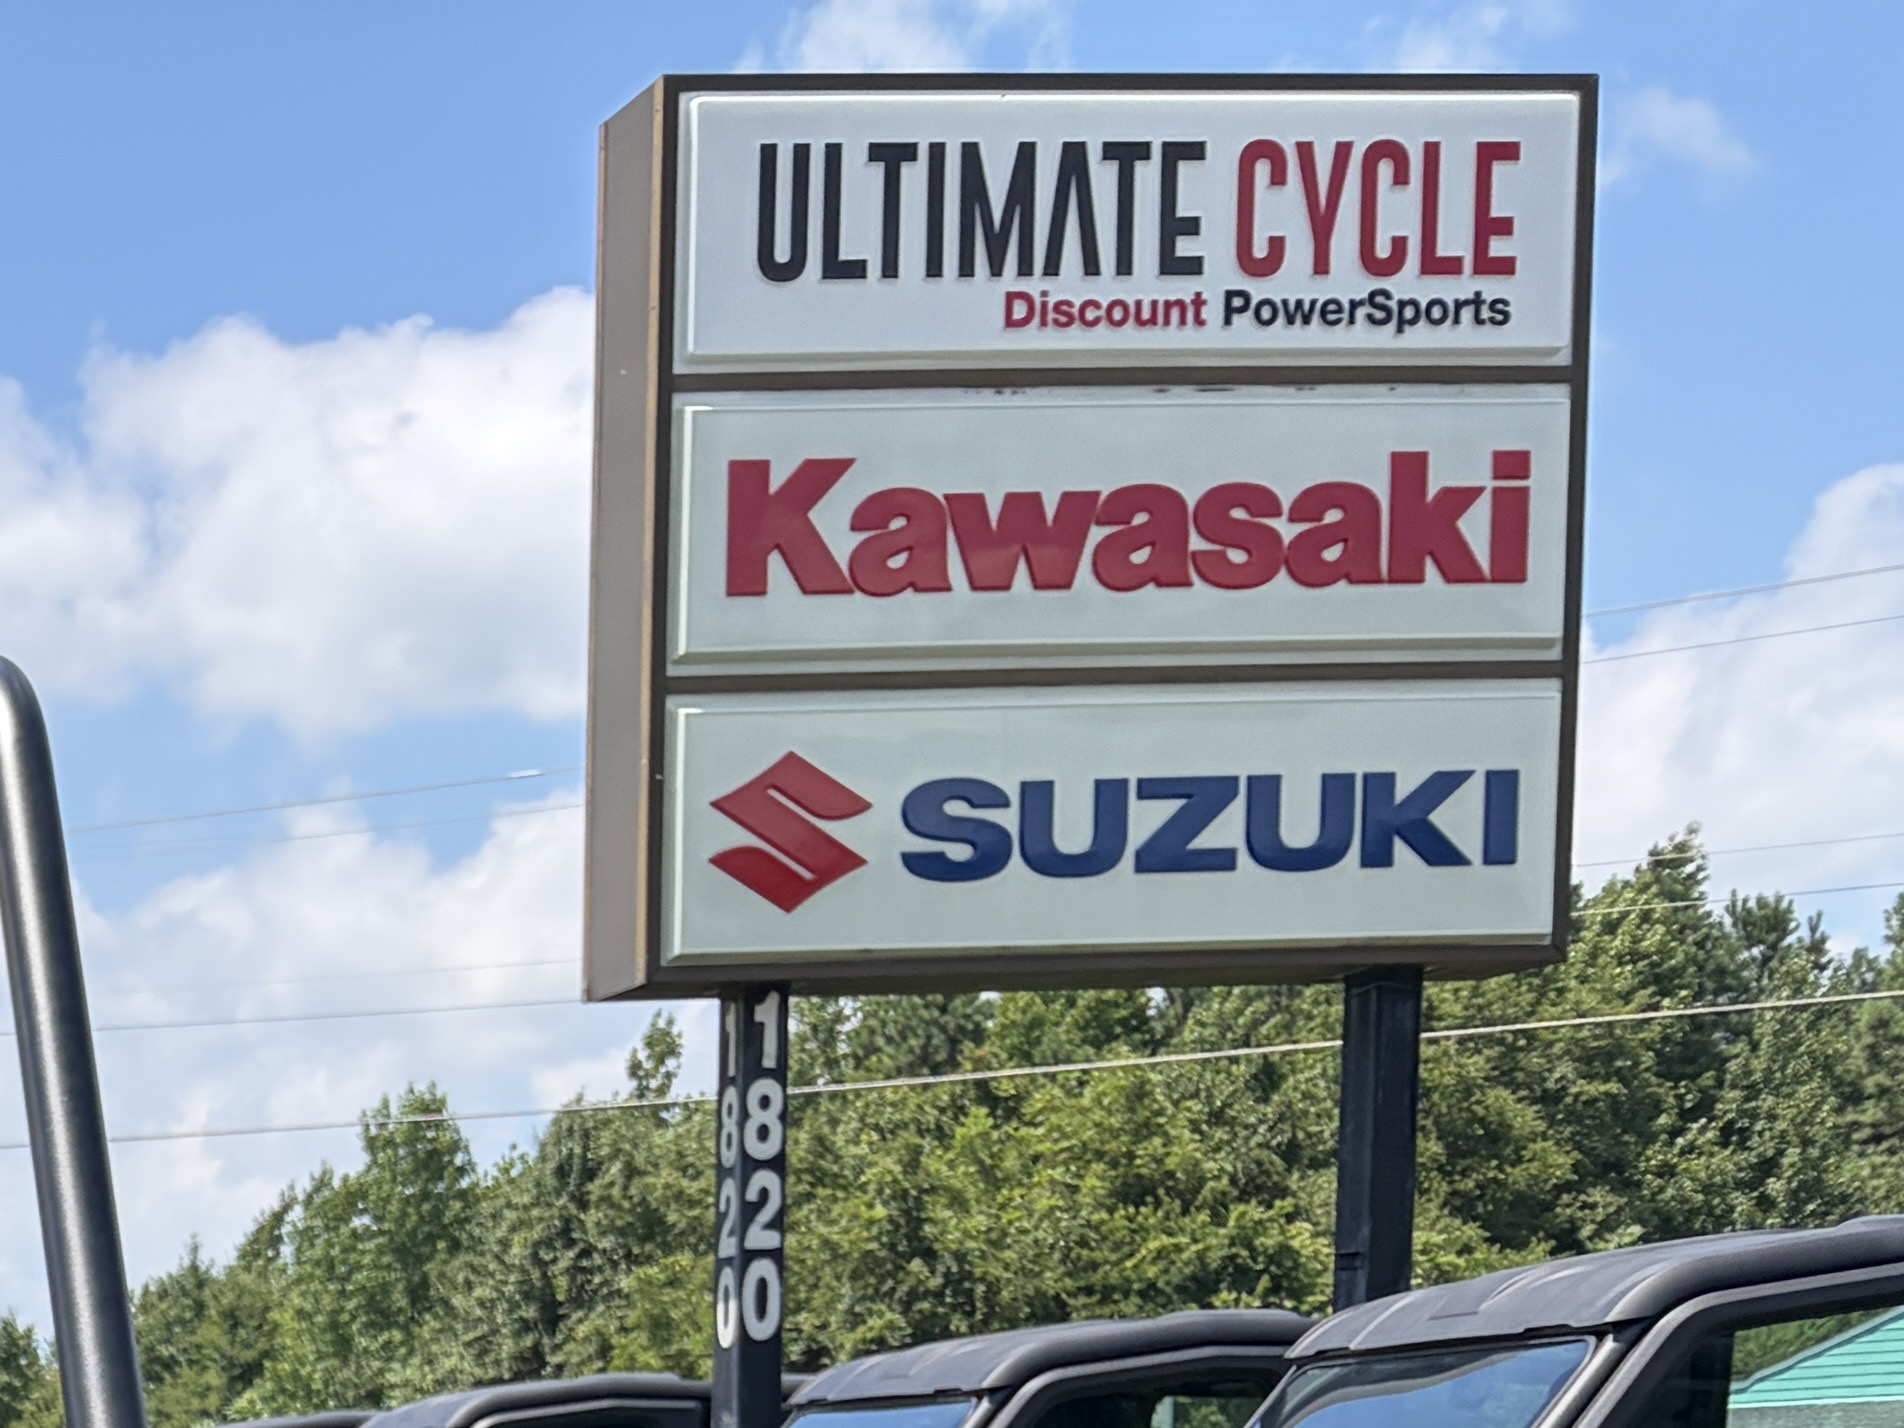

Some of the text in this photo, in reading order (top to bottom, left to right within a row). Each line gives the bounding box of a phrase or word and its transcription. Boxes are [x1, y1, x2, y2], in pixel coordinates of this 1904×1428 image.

[757, 138, 1520, 282] ULTIMATE CYCLE
[1003, 288, 1512, 335] Discount PowerSports
[726, 450, 1530, 597] Kawasaki
[899, 769, 1518, 883] SUZUKI
[742, 989, 785, 1342] 1820
